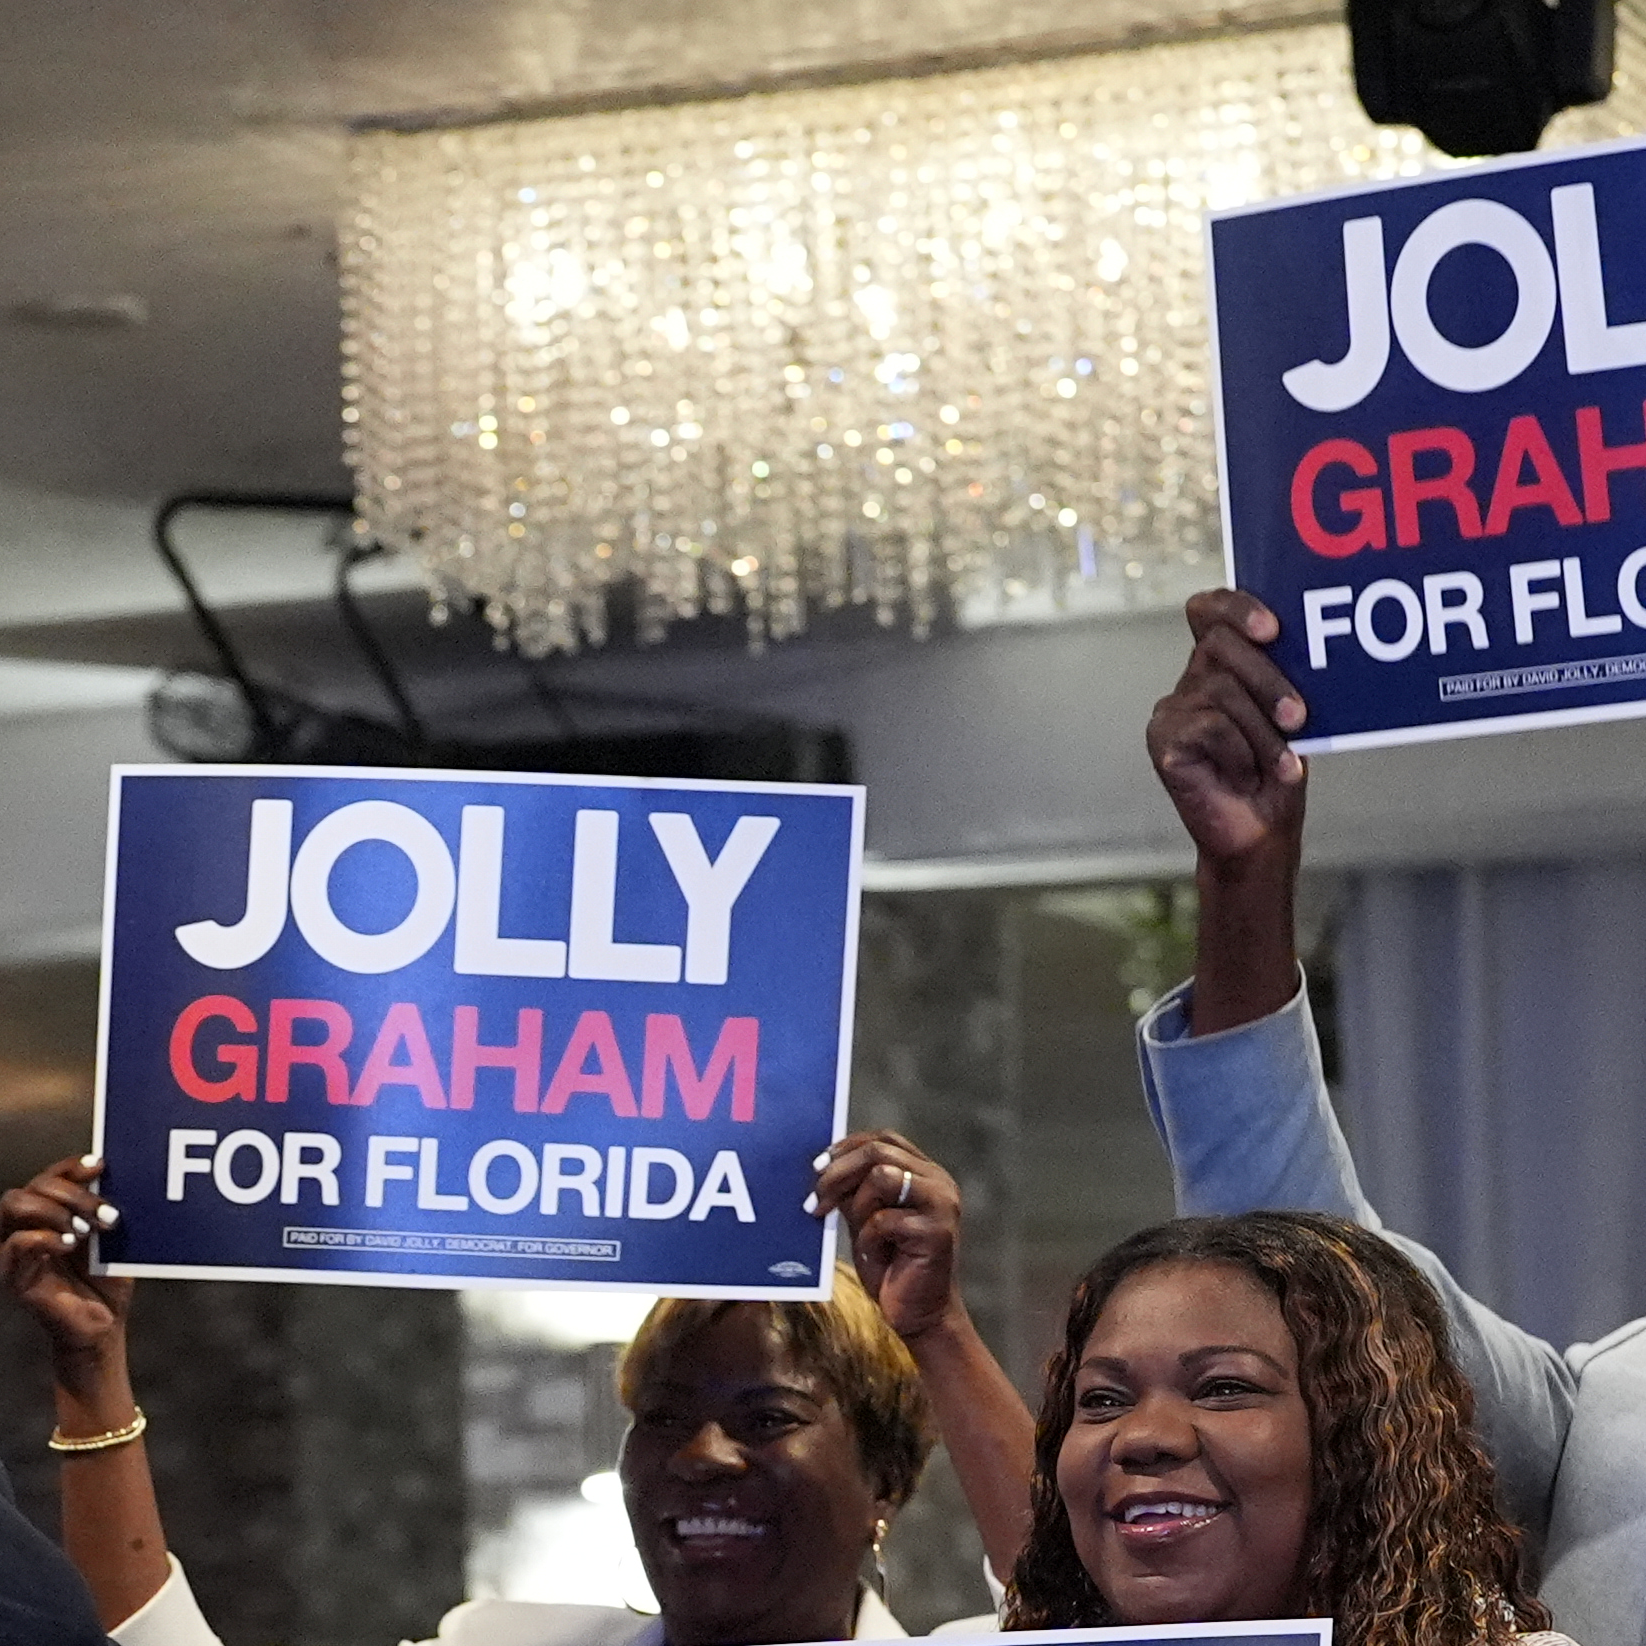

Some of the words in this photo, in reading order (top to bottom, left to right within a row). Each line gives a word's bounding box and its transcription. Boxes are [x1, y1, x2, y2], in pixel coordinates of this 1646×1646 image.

[1303, 571, 1490, 670] FOR
[175, 798, 781, 985] JOLLY
[168, 994, 760, 1122] GRAHAM
[166, 1128, 342, 1206] FOR
[364, 1134, 756, 1223] FLORIDA
